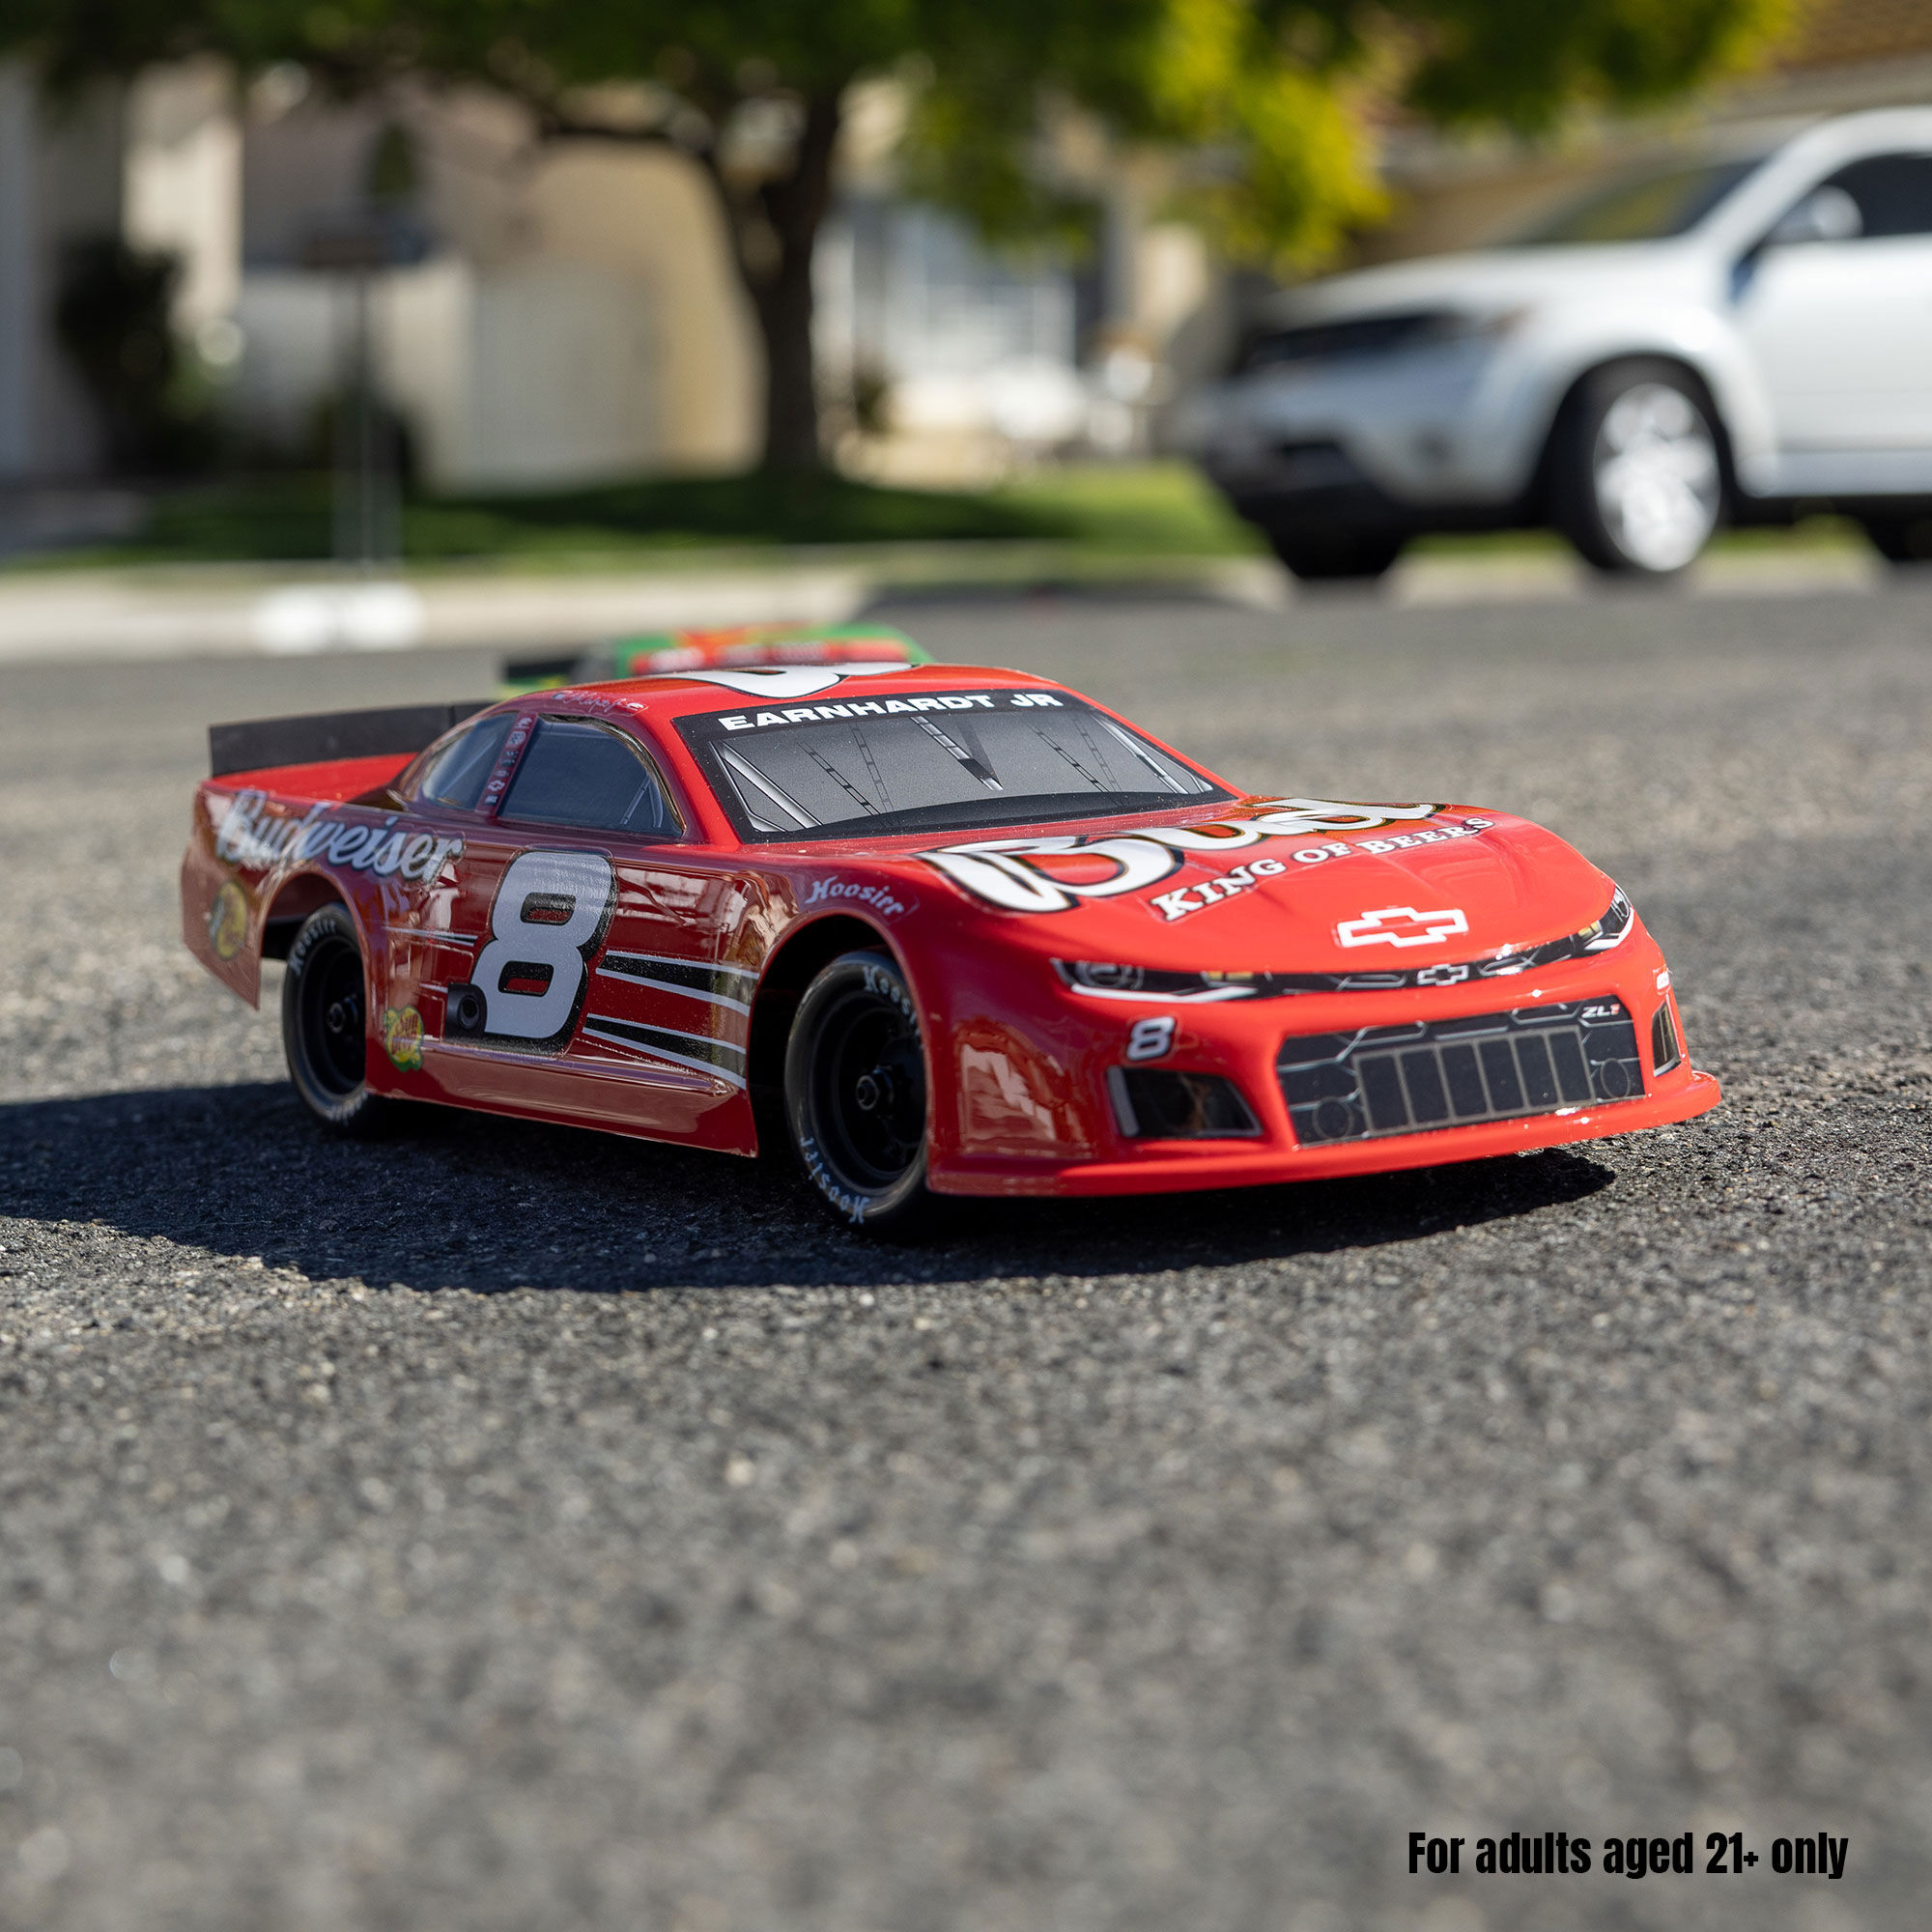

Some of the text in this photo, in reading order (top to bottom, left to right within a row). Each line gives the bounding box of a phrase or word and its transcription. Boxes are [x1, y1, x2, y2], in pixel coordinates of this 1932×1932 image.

[718, 694, 1064, 731] EARNHARDT JR
[215, 788, 467, 884] Budweiser
[921, 798, 1441, 912] Bud
[1151, 817, 1495, 921] KING OF BEERS
[805, 875, 904, 915] Hoosier
[469, 850, 614, 1043] 8
[1126, 1016, 1176, 1061] 8
